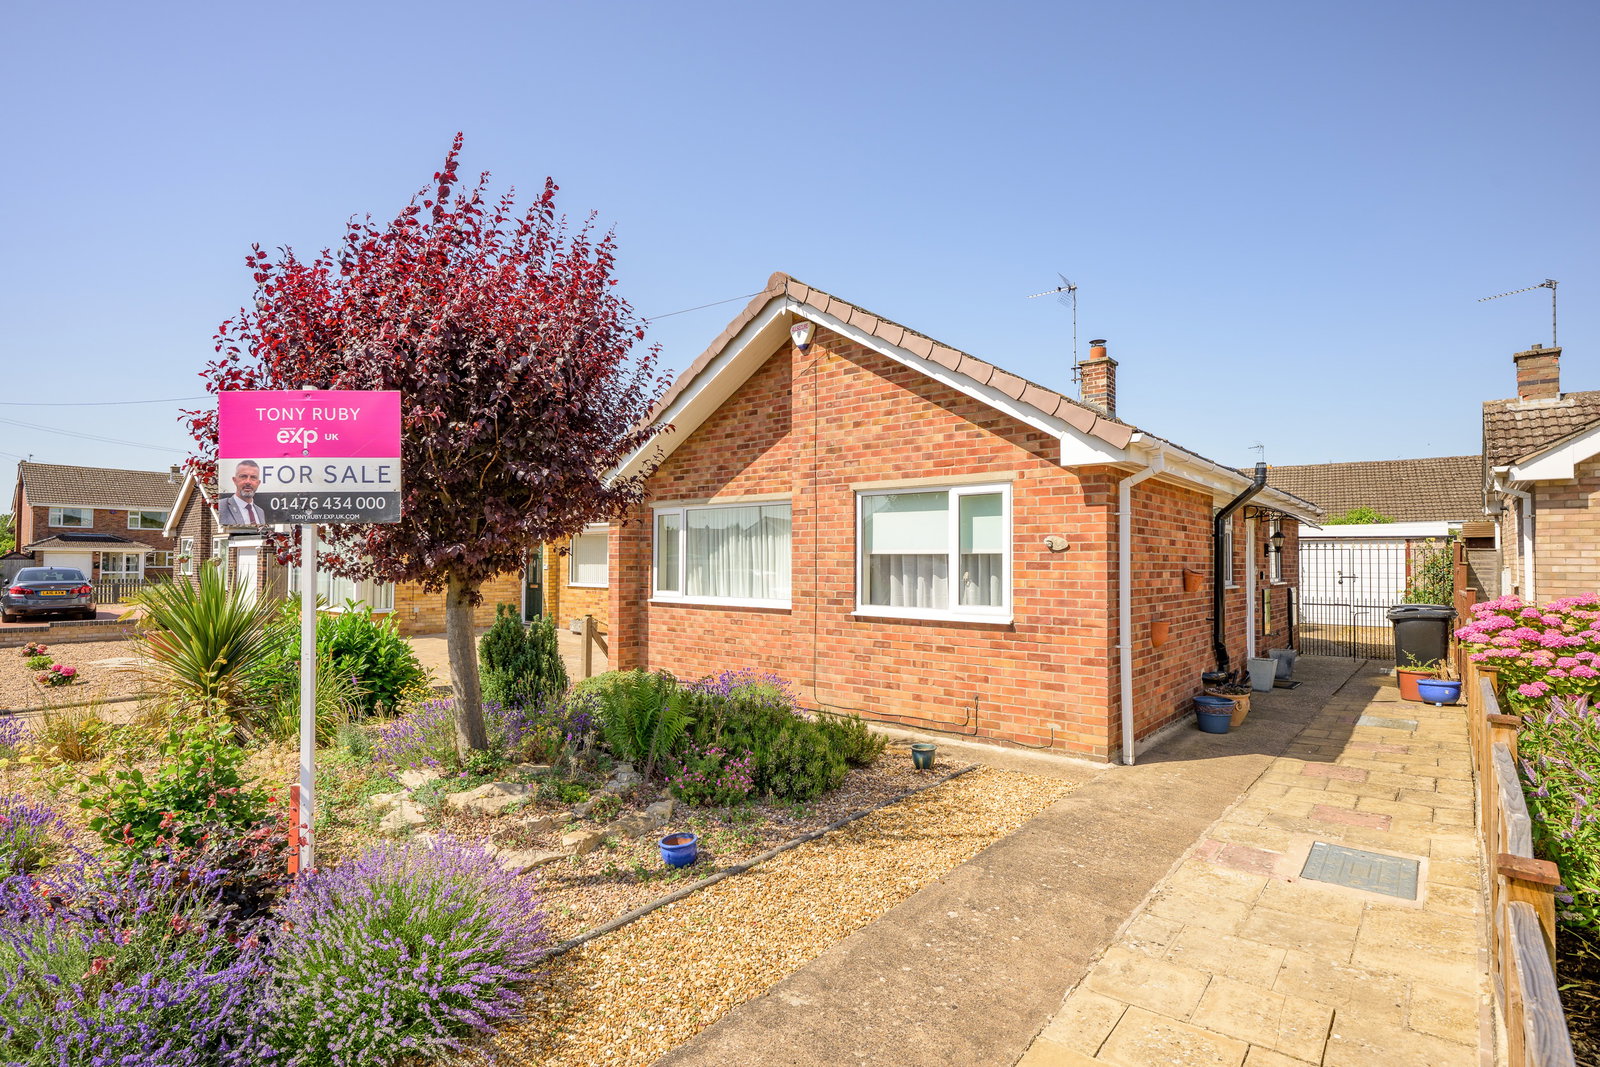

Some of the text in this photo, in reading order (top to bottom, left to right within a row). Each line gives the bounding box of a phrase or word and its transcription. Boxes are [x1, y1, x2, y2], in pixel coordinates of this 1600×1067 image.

[256, 407, 361, 421] TONY RUBY
[324, 433, 339, 441] UK
[262, 465, 391, 484] FOR SALE
[270, 496, 385, 510] 01476 434 000
